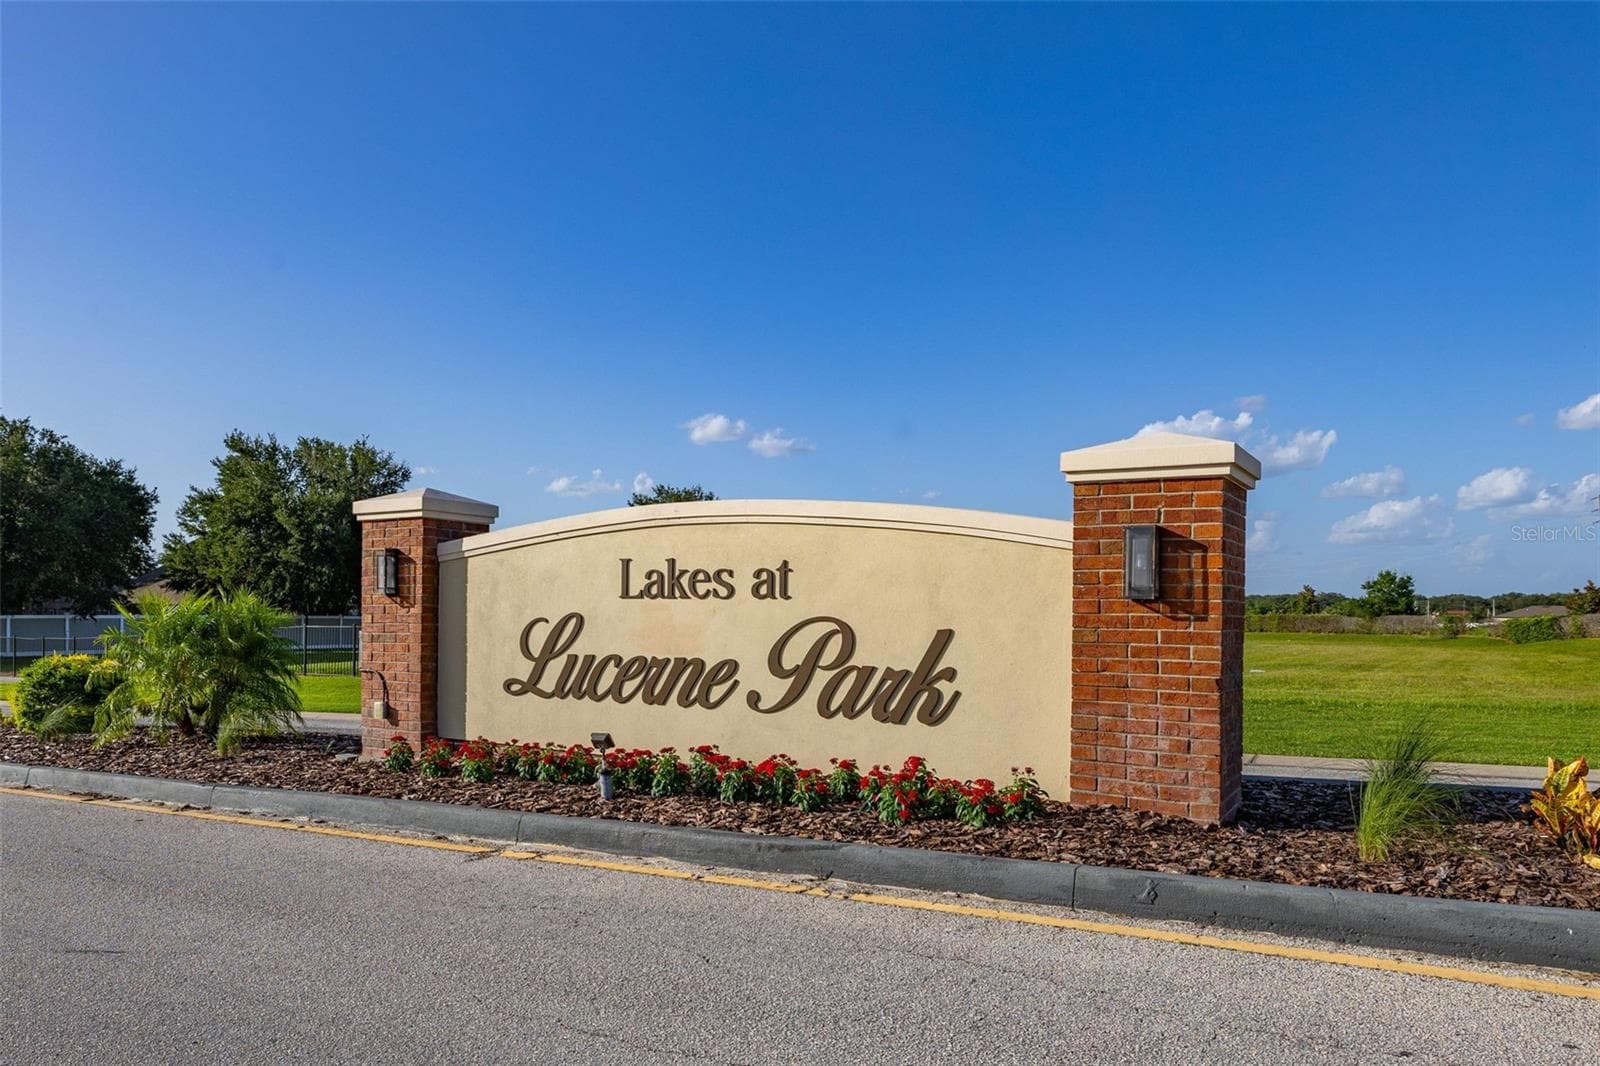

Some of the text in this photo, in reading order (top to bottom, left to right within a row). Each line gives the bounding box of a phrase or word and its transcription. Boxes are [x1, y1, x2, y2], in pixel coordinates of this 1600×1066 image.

[619, 558, 794, 600] Lakes at
[503, 612, 962, 727] Lucerne Park
